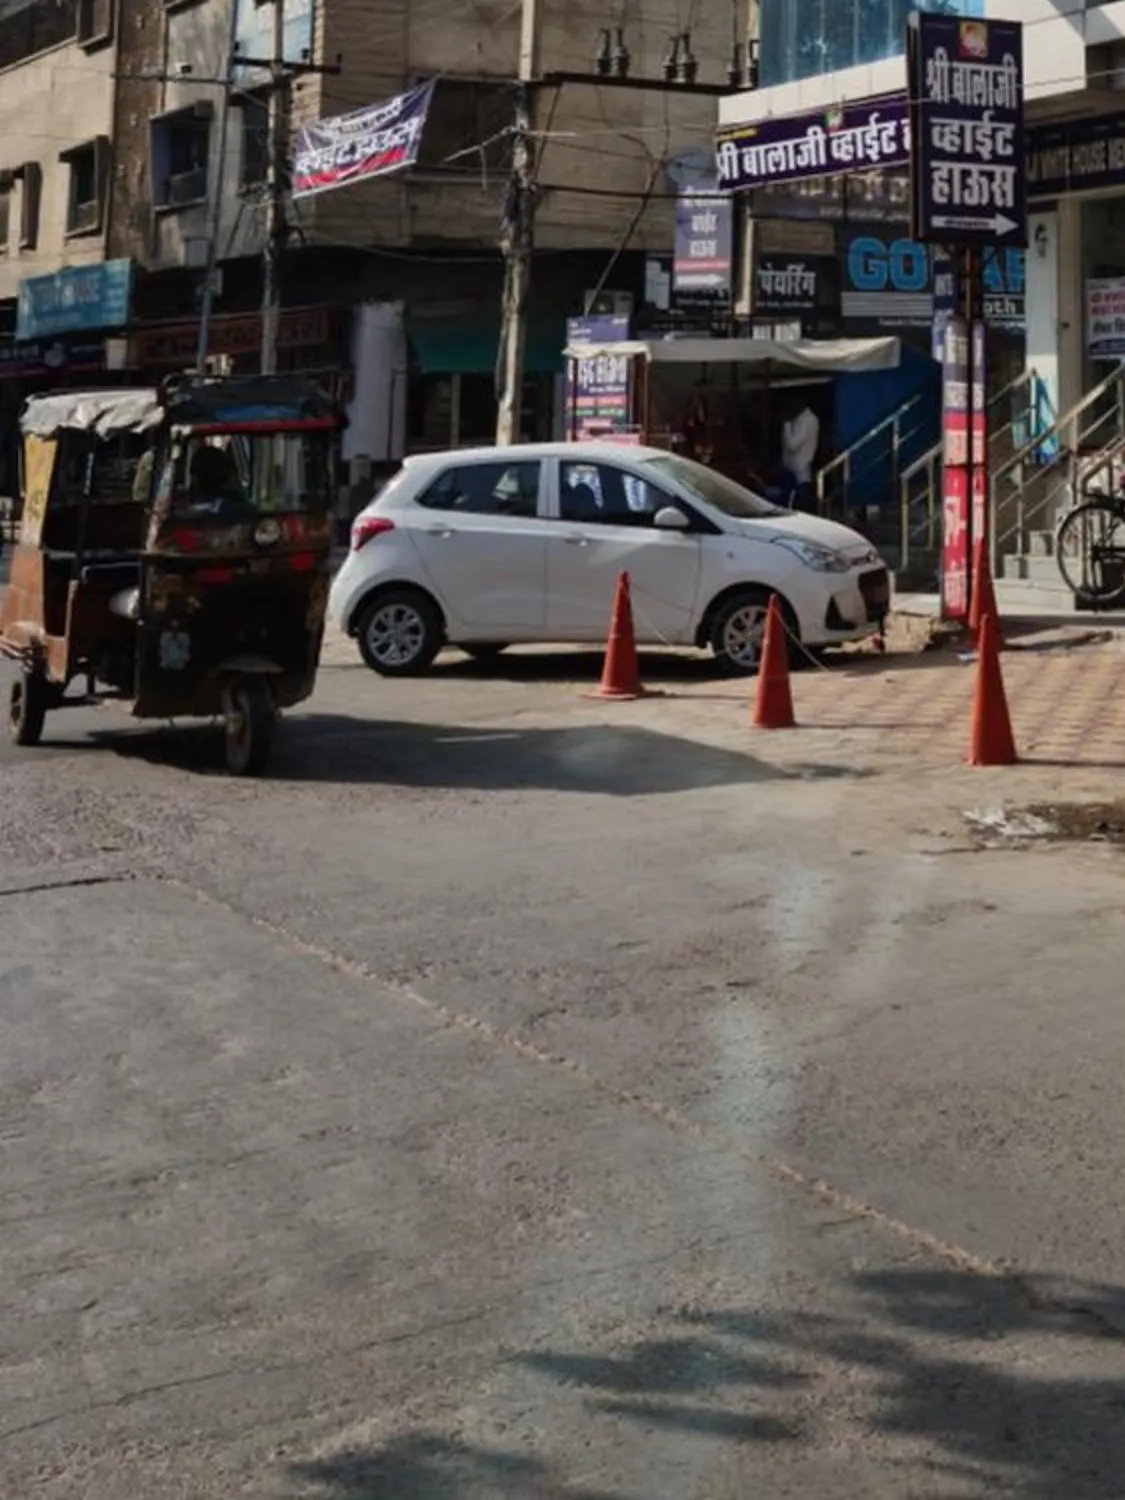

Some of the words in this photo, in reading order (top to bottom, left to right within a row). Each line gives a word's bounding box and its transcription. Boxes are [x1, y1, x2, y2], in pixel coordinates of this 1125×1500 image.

[926, 46, 948, 104] श्री
[952, 52, 1018, 109] बालाजी
[742, 125, 826, 177] बालाजी
[828, 113, 898, 164] व्हाईट
[929, 110, 1015, 161] व्हाईट
[929, 161, 1016, 208] हाऊस
